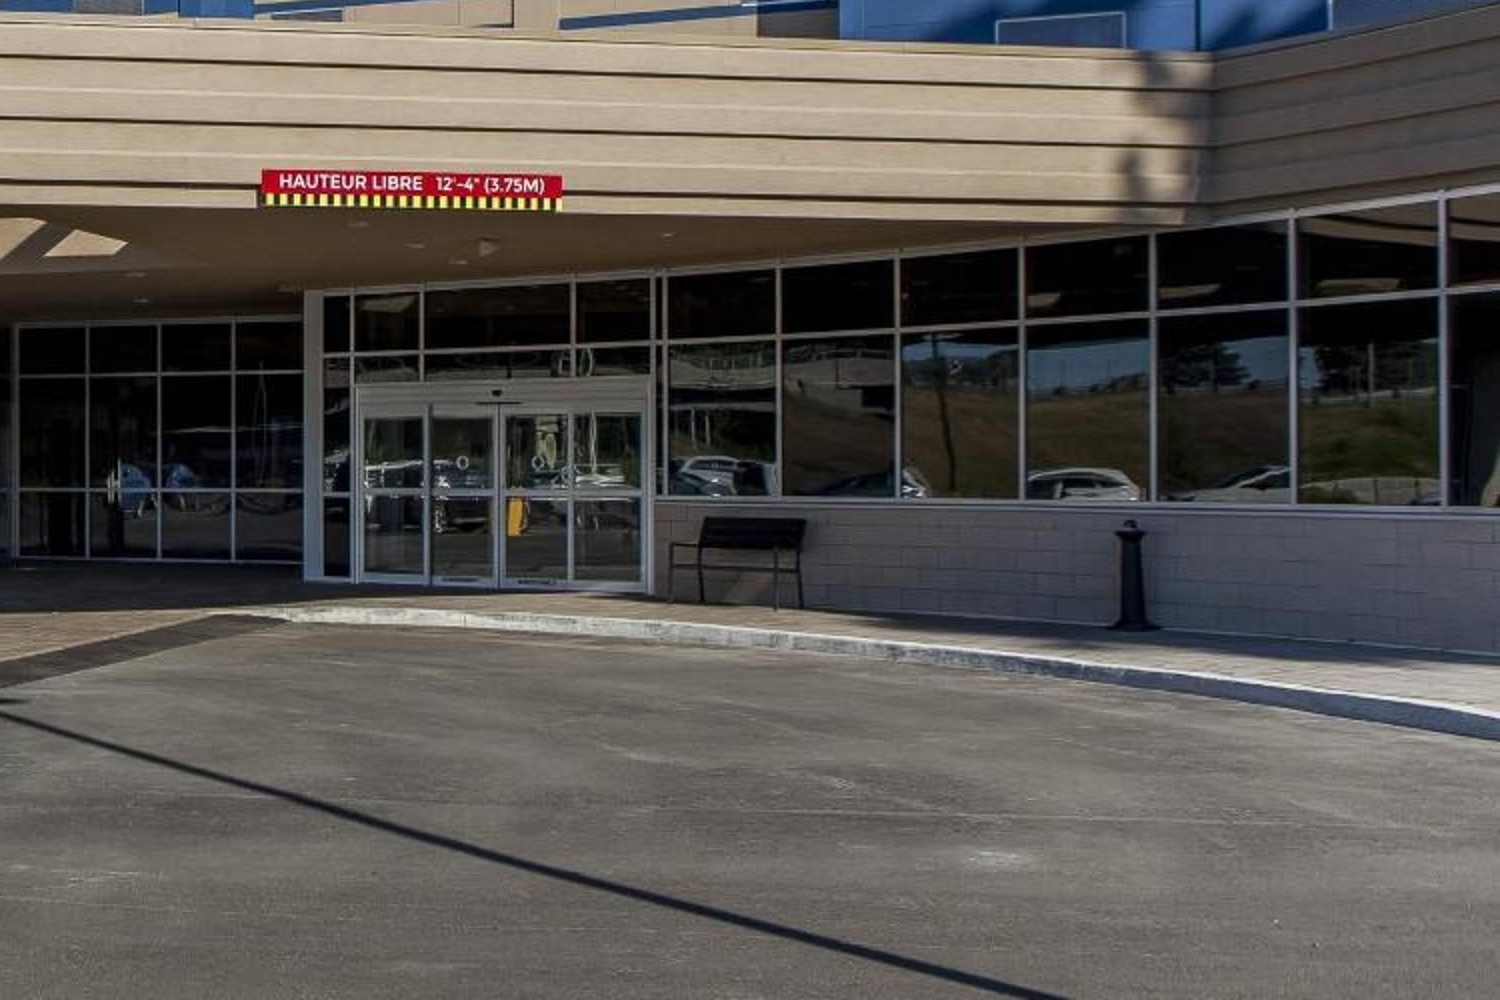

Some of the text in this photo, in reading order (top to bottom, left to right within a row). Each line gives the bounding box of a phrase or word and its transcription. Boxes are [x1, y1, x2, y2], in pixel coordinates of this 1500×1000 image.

[279, 173, 367, 190] HAUTEUR
[372, 175, 424, 191] LIBRE
[483, 176, 546, 196] (3.75M)
